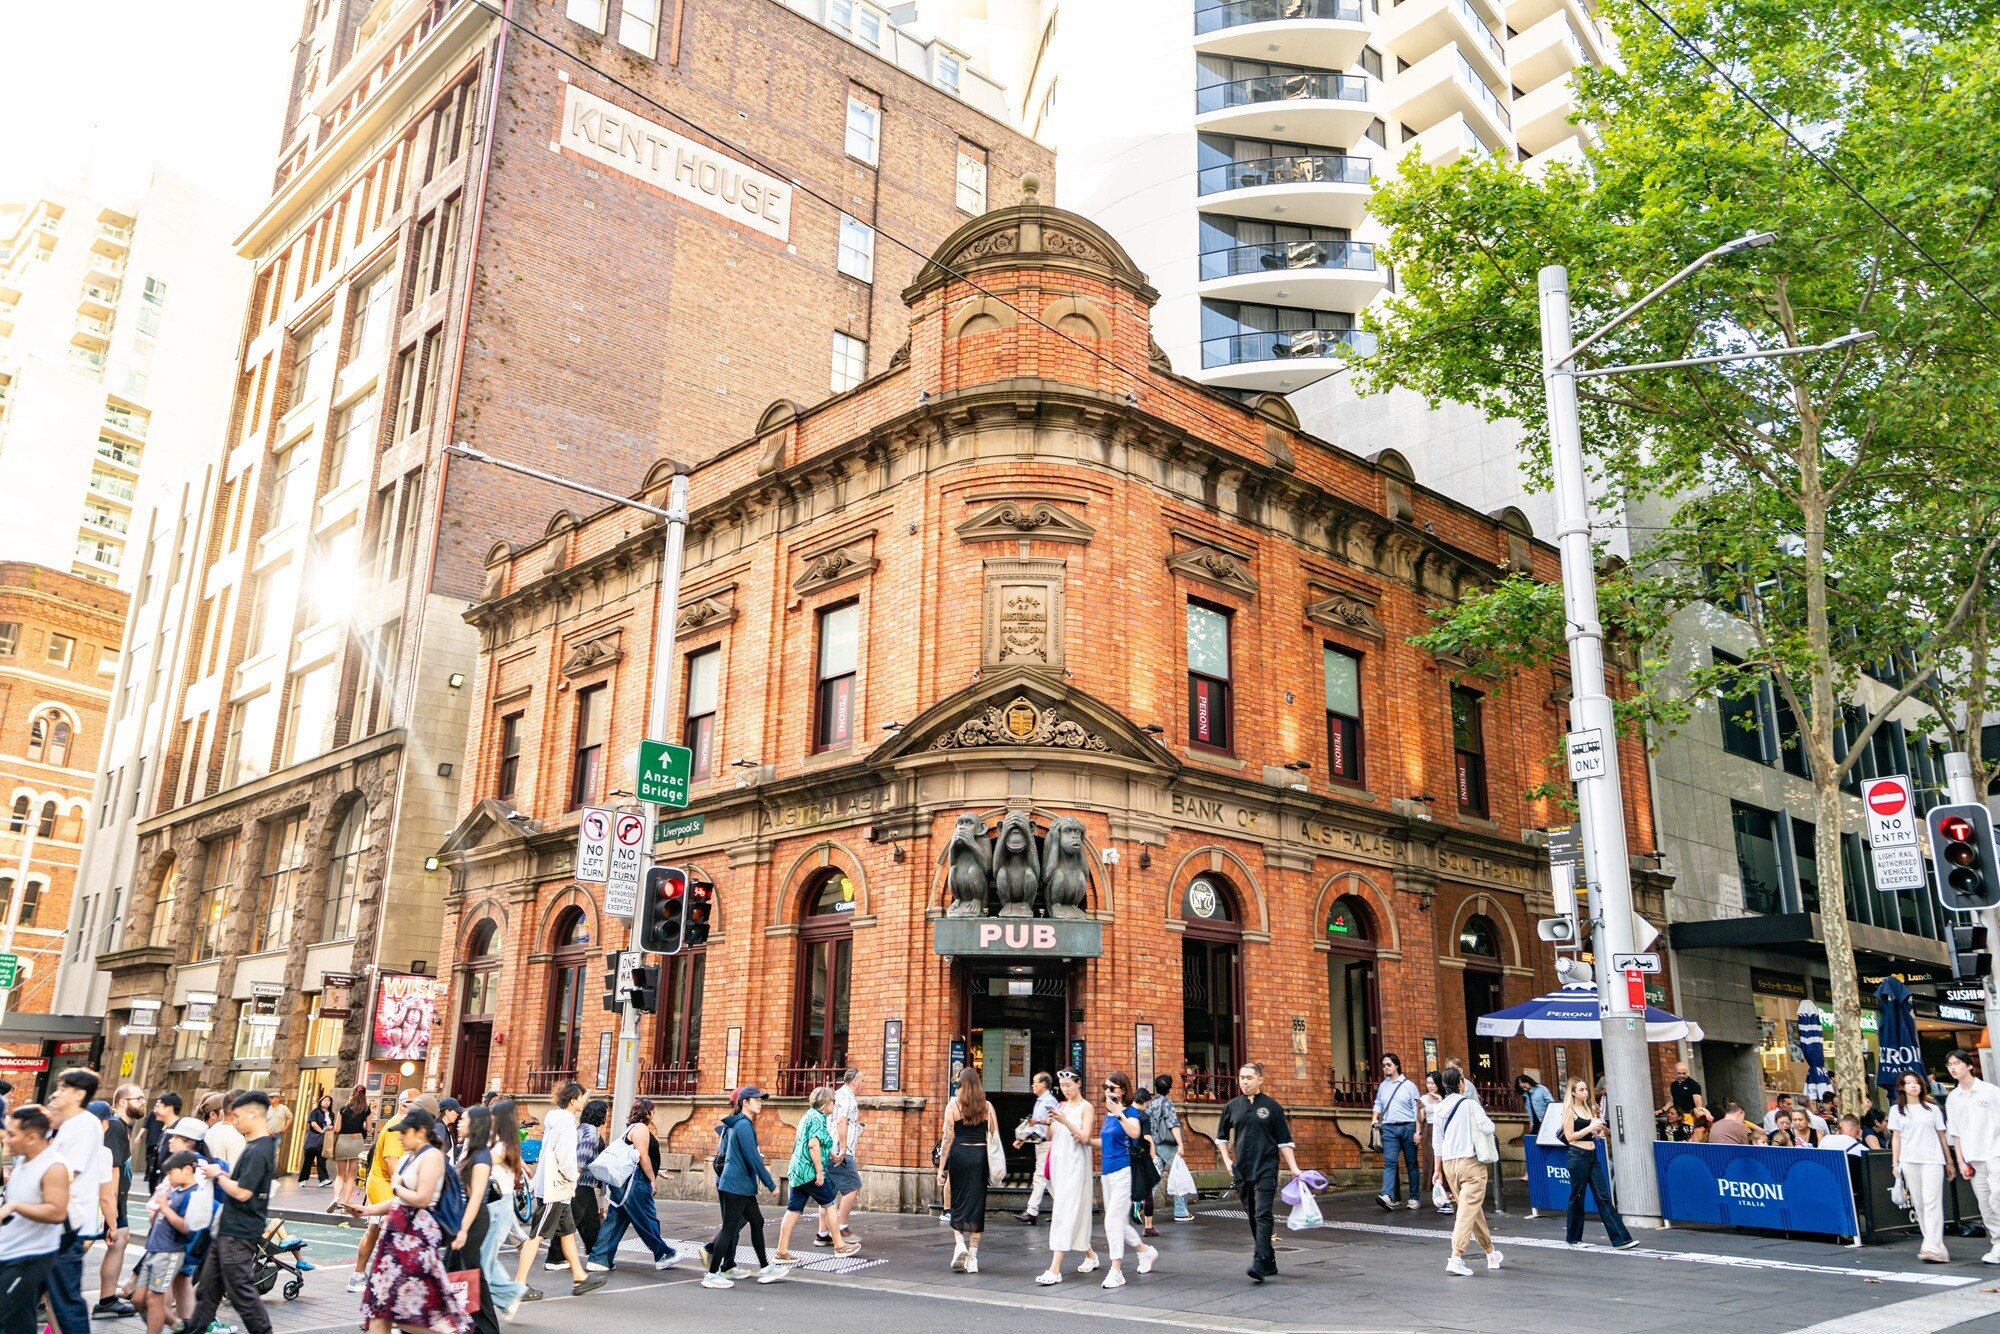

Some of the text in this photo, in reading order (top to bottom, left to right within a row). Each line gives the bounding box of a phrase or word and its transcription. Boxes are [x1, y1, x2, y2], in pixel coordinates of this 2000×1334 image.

[572, 101, 781, 225] KENT HOUSE
[839, 693, 848, 733] PERONI
[1199, 694, 1208, 735] PERONI
[702, 731, 710, 766] PERONI
[1334, 732, 1342, 769] PERONI
[1575, 758, 1601, 772] ONLY
[589, 762, 598, 794] PERONI
[643, 770, 684, 787] Anzac
[1459, 766, 1468, 801] PERONI
[641, 783, 684, 802] Bridge
[760, 790, 892, 831] AUSTRALASIA
[1171, 794, 1262, 831] BANK OF
[663, 821, 701, 838] Liverpool St
[1881, 819, 1902, 831] NO
[1301, 821, 1408, 861] AUSTRALASIA
[1875, 831, 1912, 843] ENTRY
[586, 844, 604, 857] NO
[618, 848, 636, 861] NO
[1878, 849, 1914, 860] LIGHT RAIL
[582, 858, 604, 868] LEFT
[613, 861, 638, 872] RIGHT
[1437, 850, 1532, 887] SOUTHERN
[1877, 859, 1918, 869] AUTHORISED
[582, 867, 604, 878] TURN
[613, 871, 636, 881] TURN
[1882, 866, 1915, 876] VEHICLE
[1881, 874, 1919, 885] EXCEPTED
[610, 882, 635, 891] LIGHT RAIL
[608, 890, 636, 899] AUTHORISED
[610, 897, 632, 905] VEHICLE
[607, 904, 633, 912] EXCEPTED
[979, 923, 1057, 949] PUB
[622, 957, 636, 969] ONE
[620, 971, 632, 982] WA
[1907, 973, 1933, 982] Lunch
[1946, 989, 1977, 1001] SUSHI
[1546, 1010, 1593, 1018] PERONI
[1546, 1165, 1570, 1179] PER
[1717, 1178, 1784, 1201] PERONI
[1738, 1199, 1766, 1208] ITALIA
